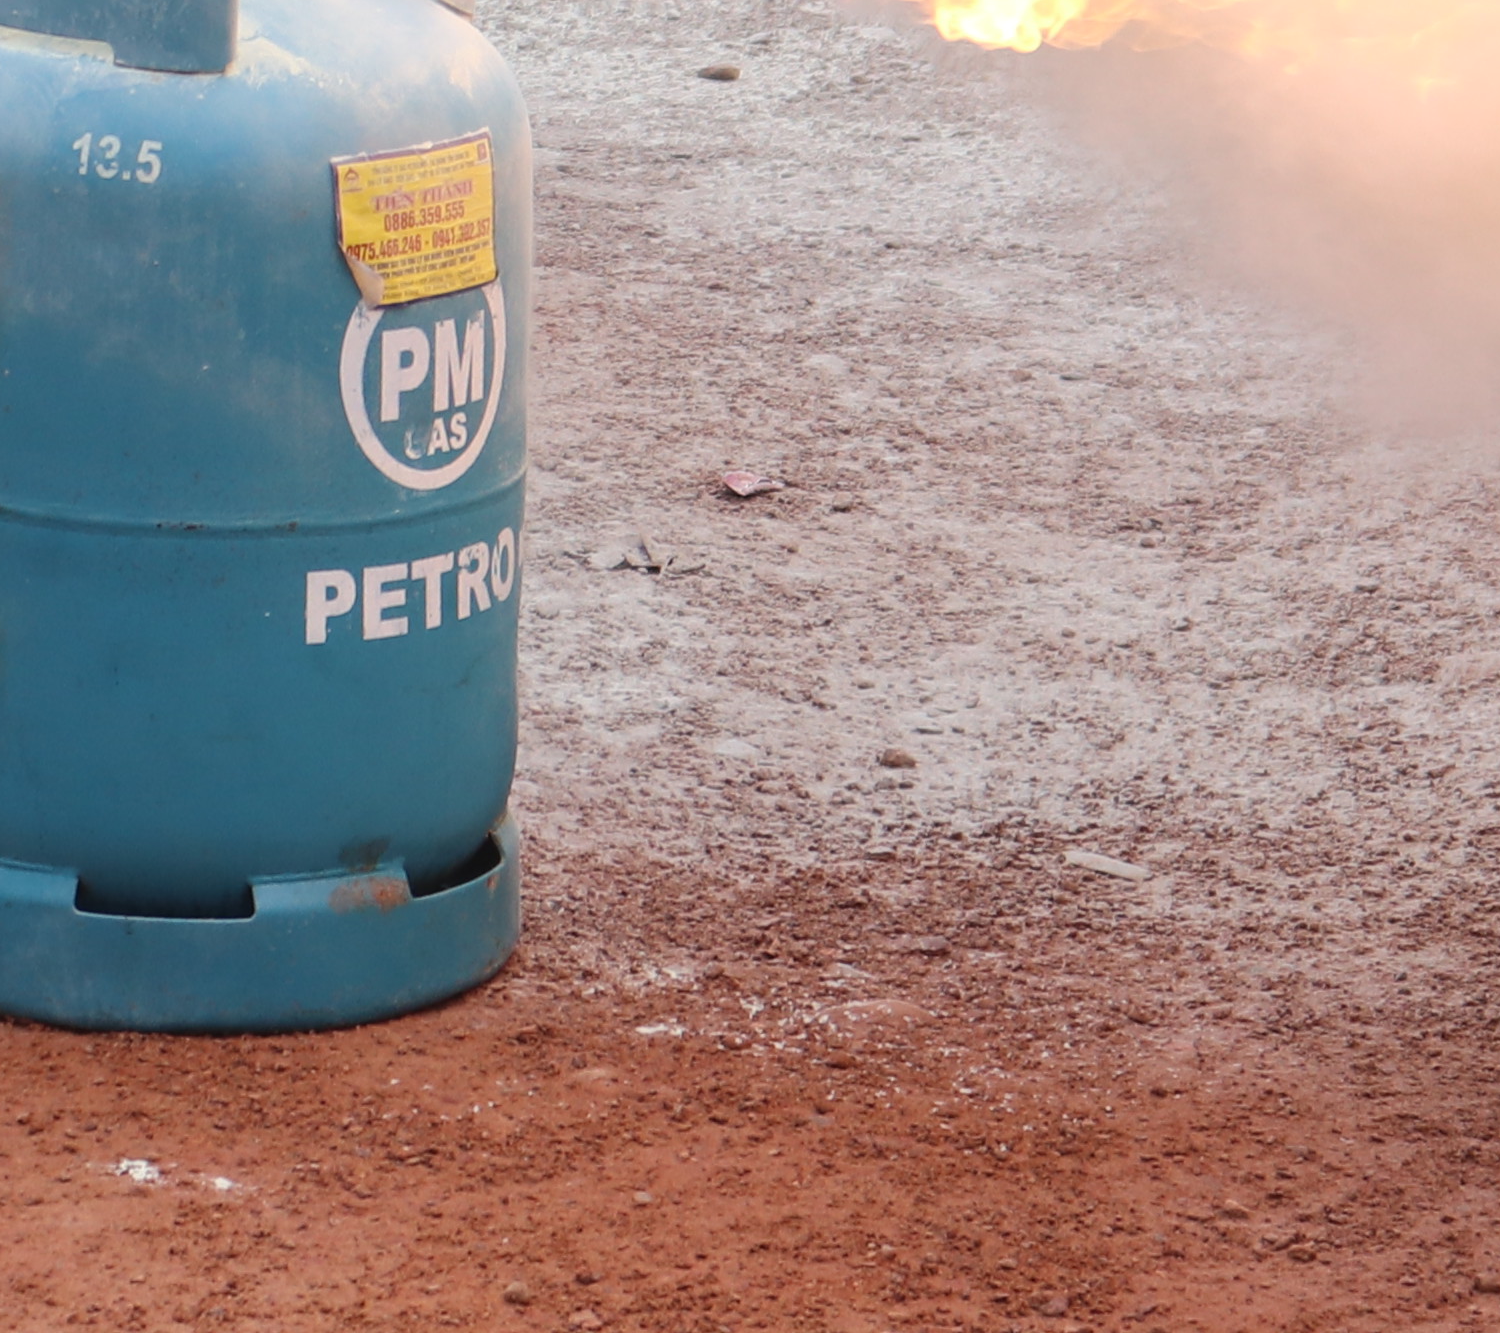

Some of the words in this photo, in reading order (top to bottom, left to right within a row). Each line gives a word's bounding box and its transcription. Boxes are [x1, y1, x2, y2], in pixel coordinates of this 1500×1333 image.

[73, 132, 163, 185] 13.5
[383, 200, 466, 233] 0886.359.555
[380, 309, 486, 422] PM
[305, 526, 523, 645] PETRO
